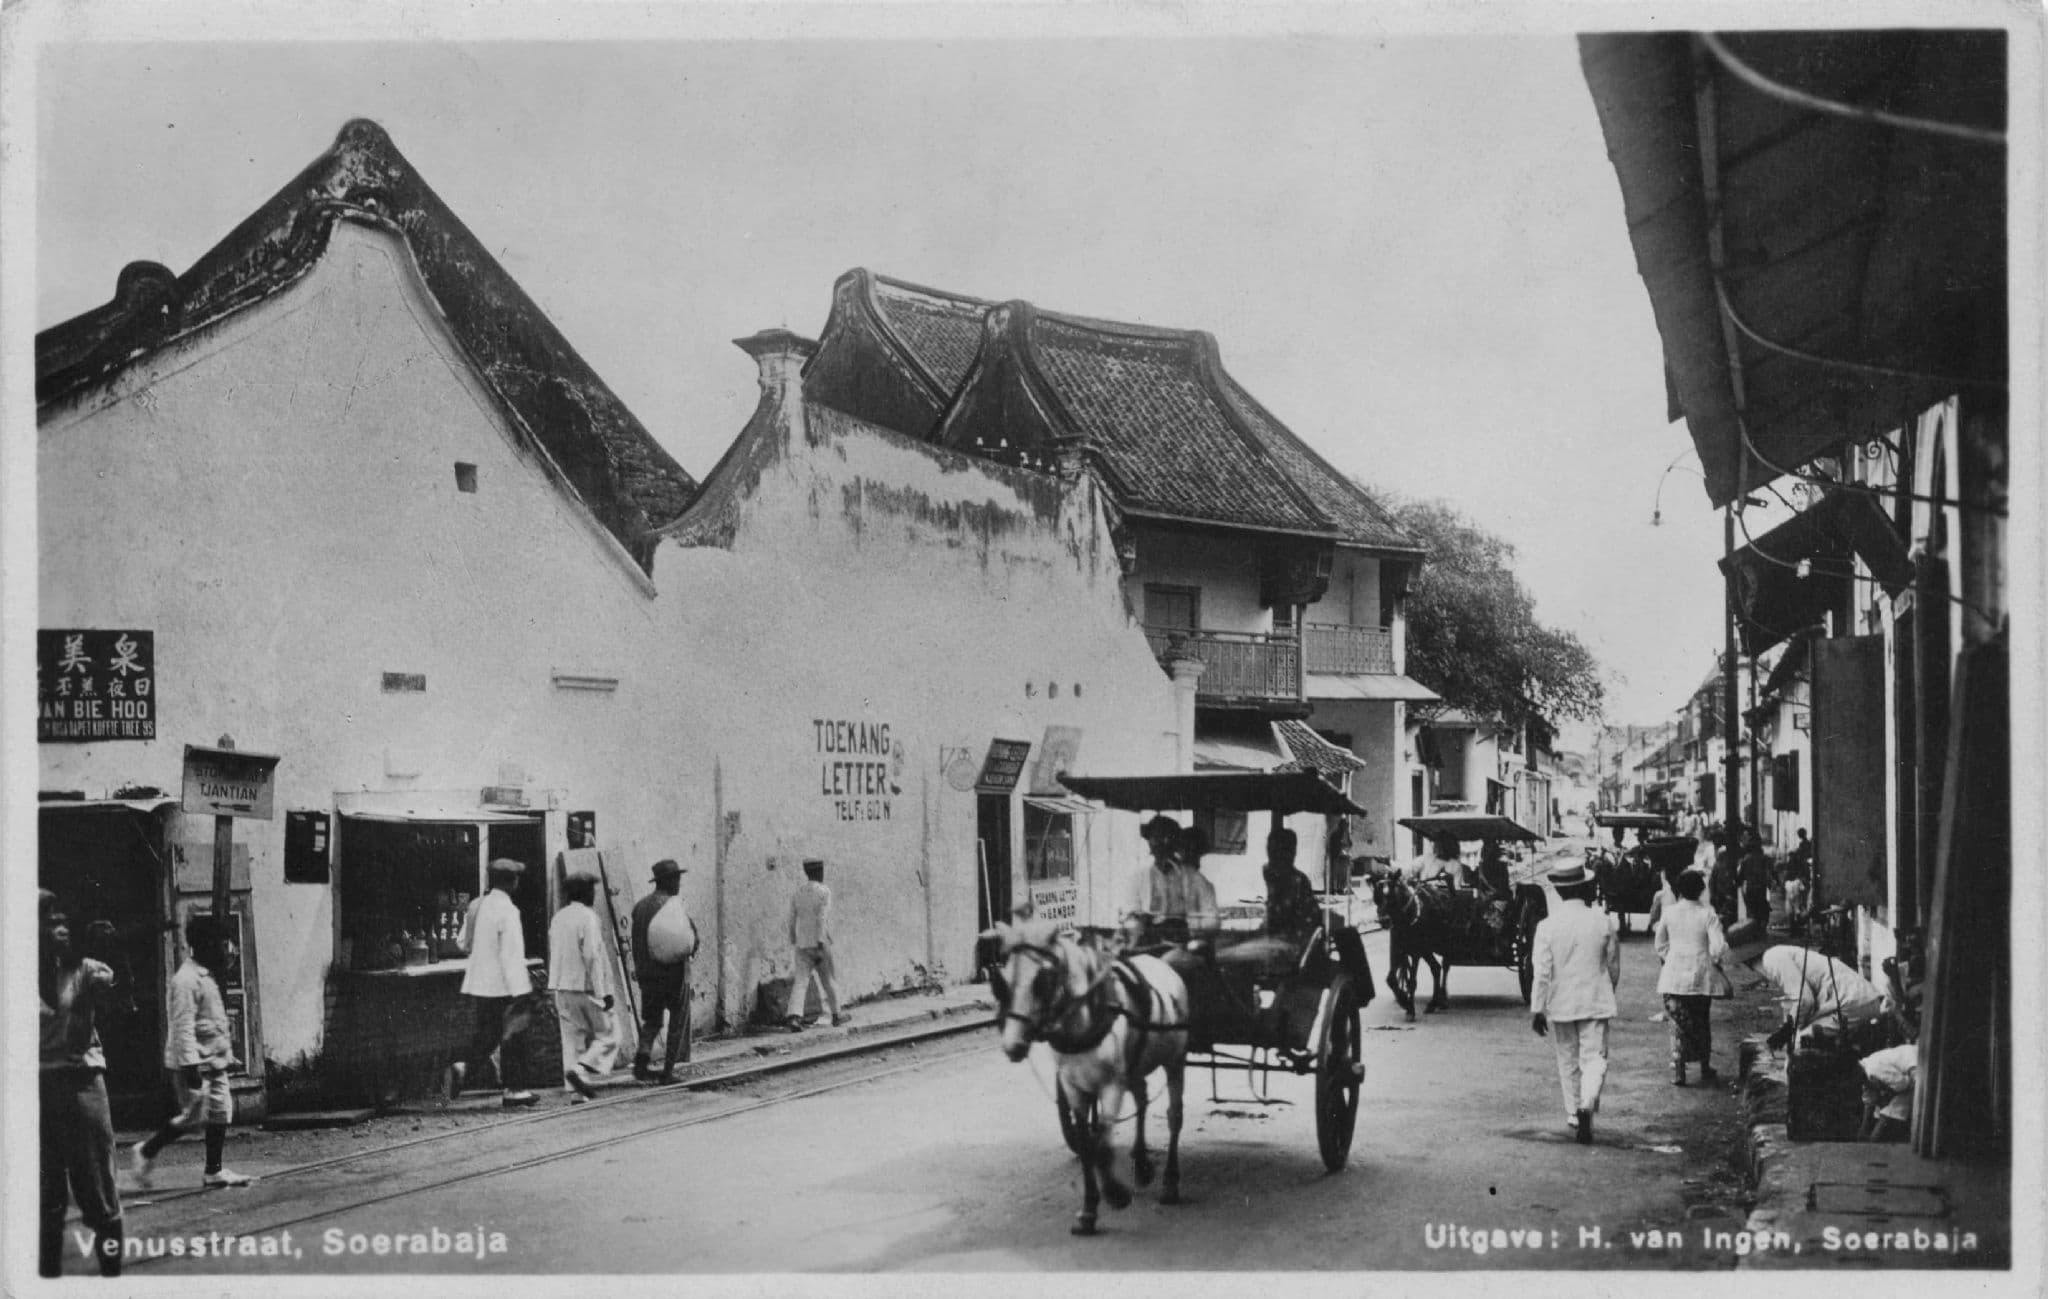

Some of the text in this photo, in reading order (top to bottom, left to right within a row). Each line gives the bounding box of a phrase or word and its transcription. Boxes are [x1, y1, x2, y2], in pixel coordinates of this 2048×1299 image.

[39, 633, 146, 677] 泉美
[38, 700, 148, 719] AN BIE HOO
[121, 720, 141, 736] THEE
[813, 718, 891, 755] TOEKANG
[200, 782, 258, 801] TJANTIAN
[822, 761, 887, 796] LETTER
